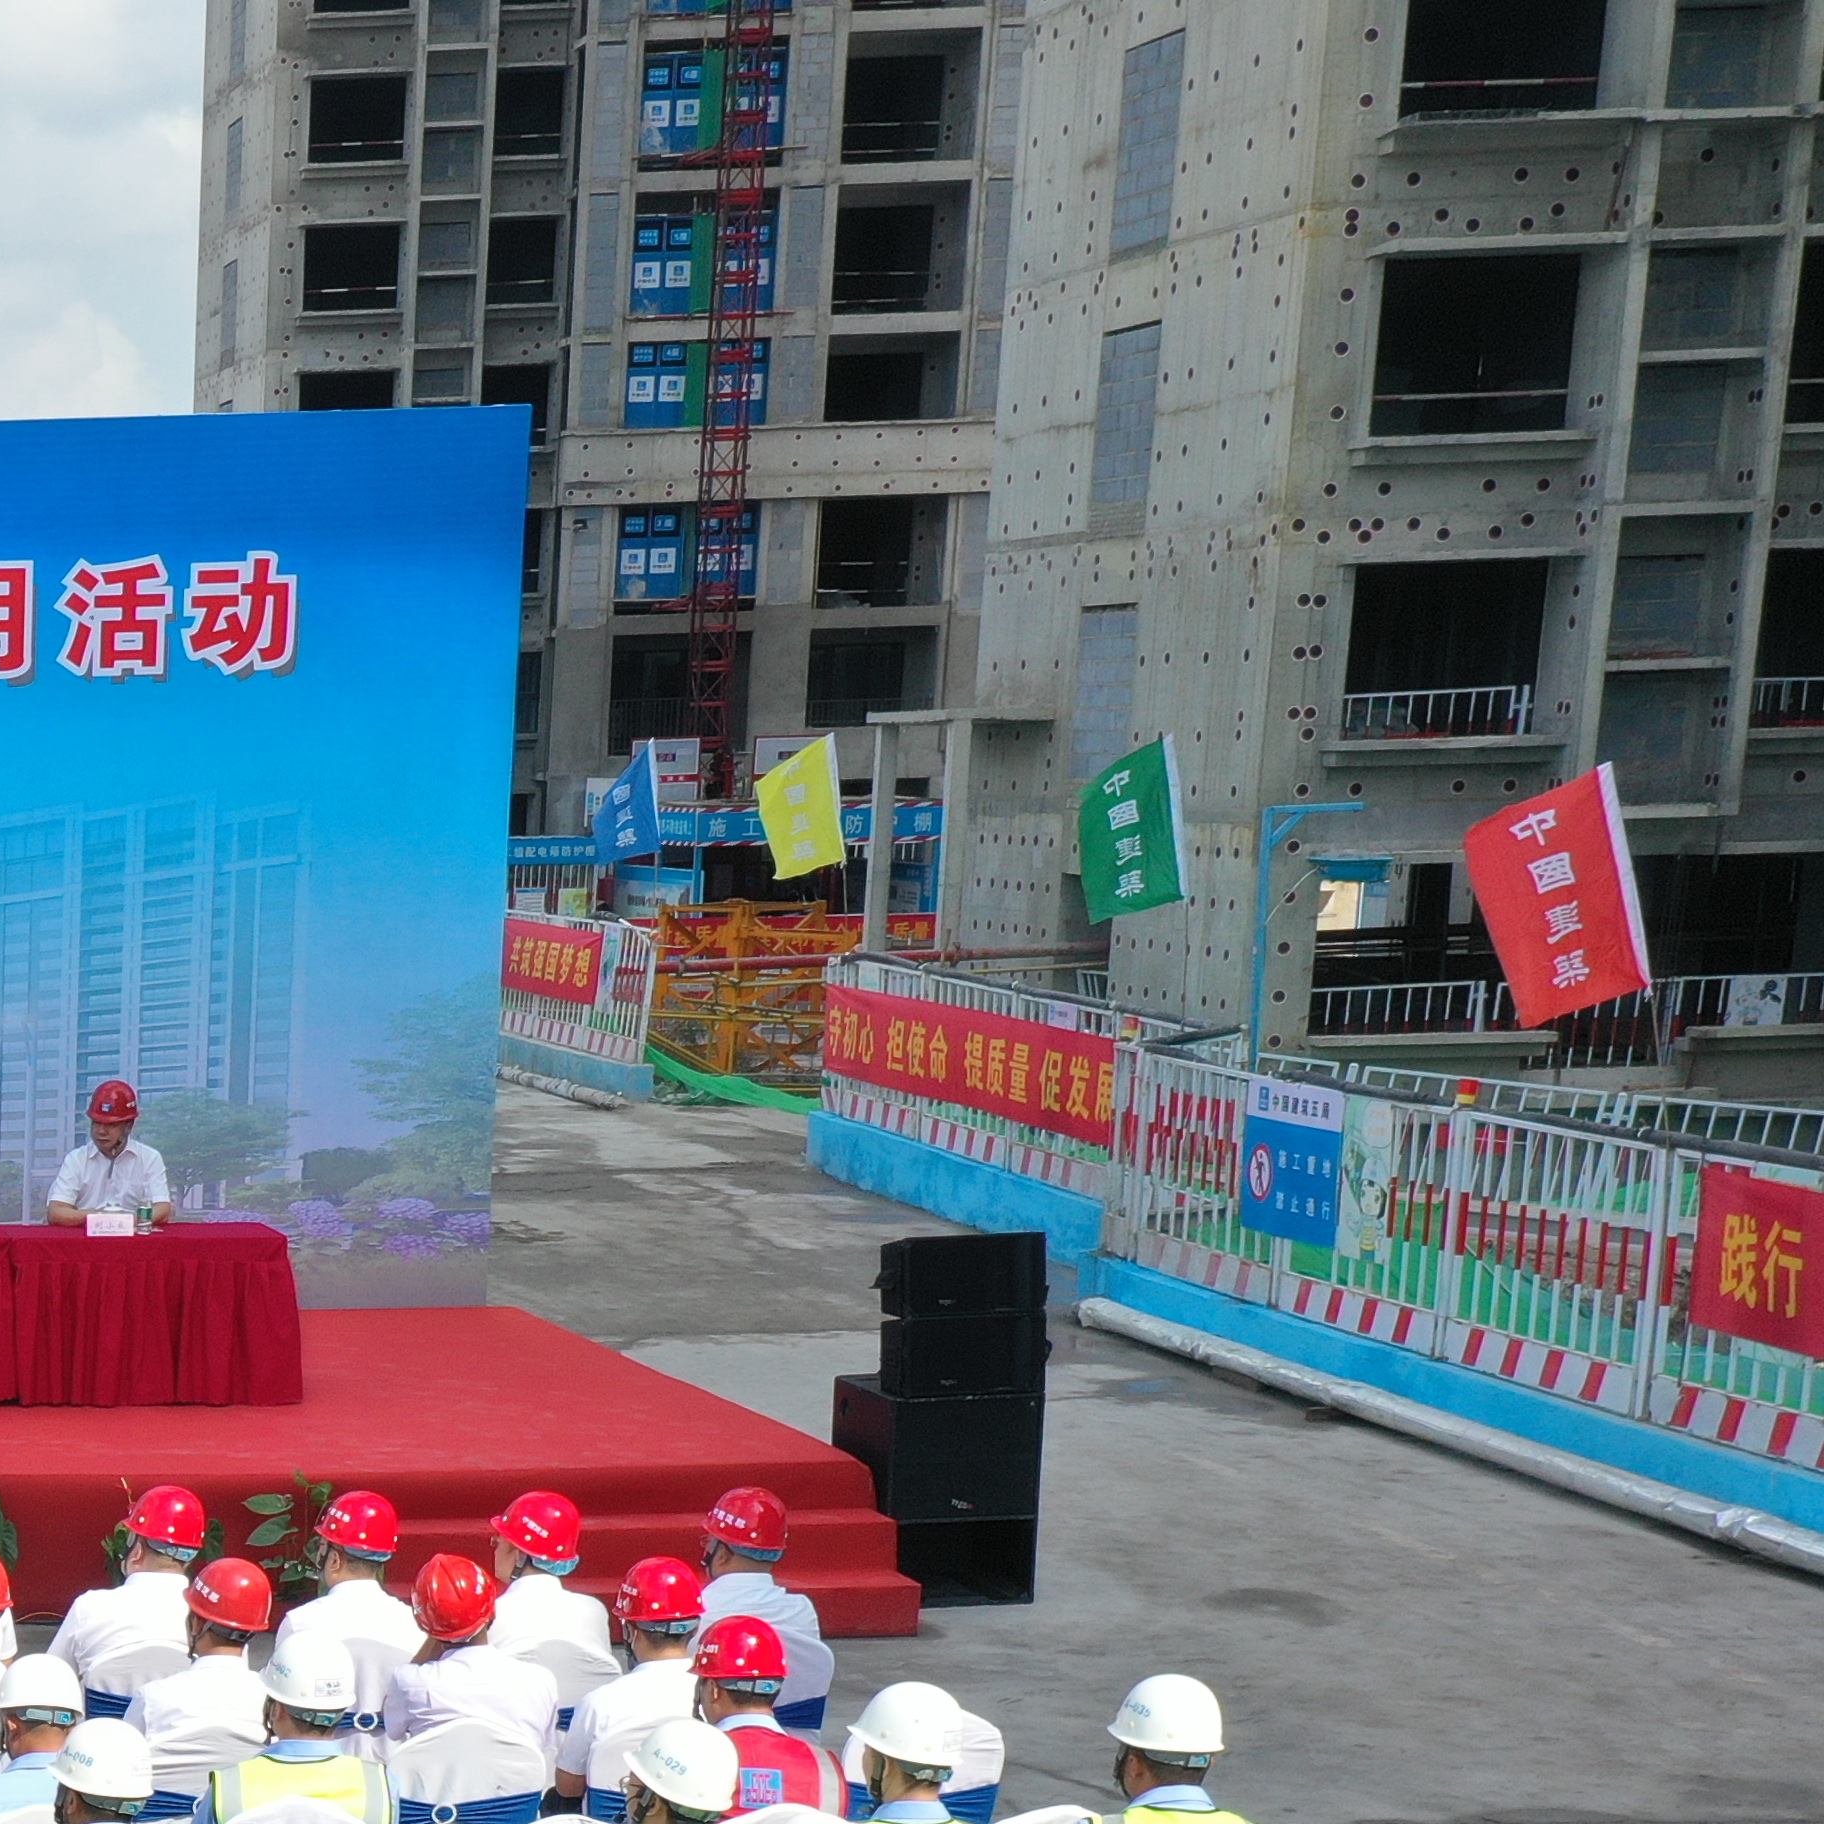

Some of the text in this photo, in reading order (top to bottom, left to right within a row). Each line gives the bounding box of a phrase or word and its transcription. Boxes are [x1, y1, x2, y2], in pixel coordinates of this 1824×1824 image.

[829, 1005, 874, 1064] 守初心
[887, 1016, 949, 1083] 担使命
[964, 1031, 1030, 1104] 提质量
[1719, 1214, 1804, 1319] 践行
[654, 1748, 689, 1777] A-029
